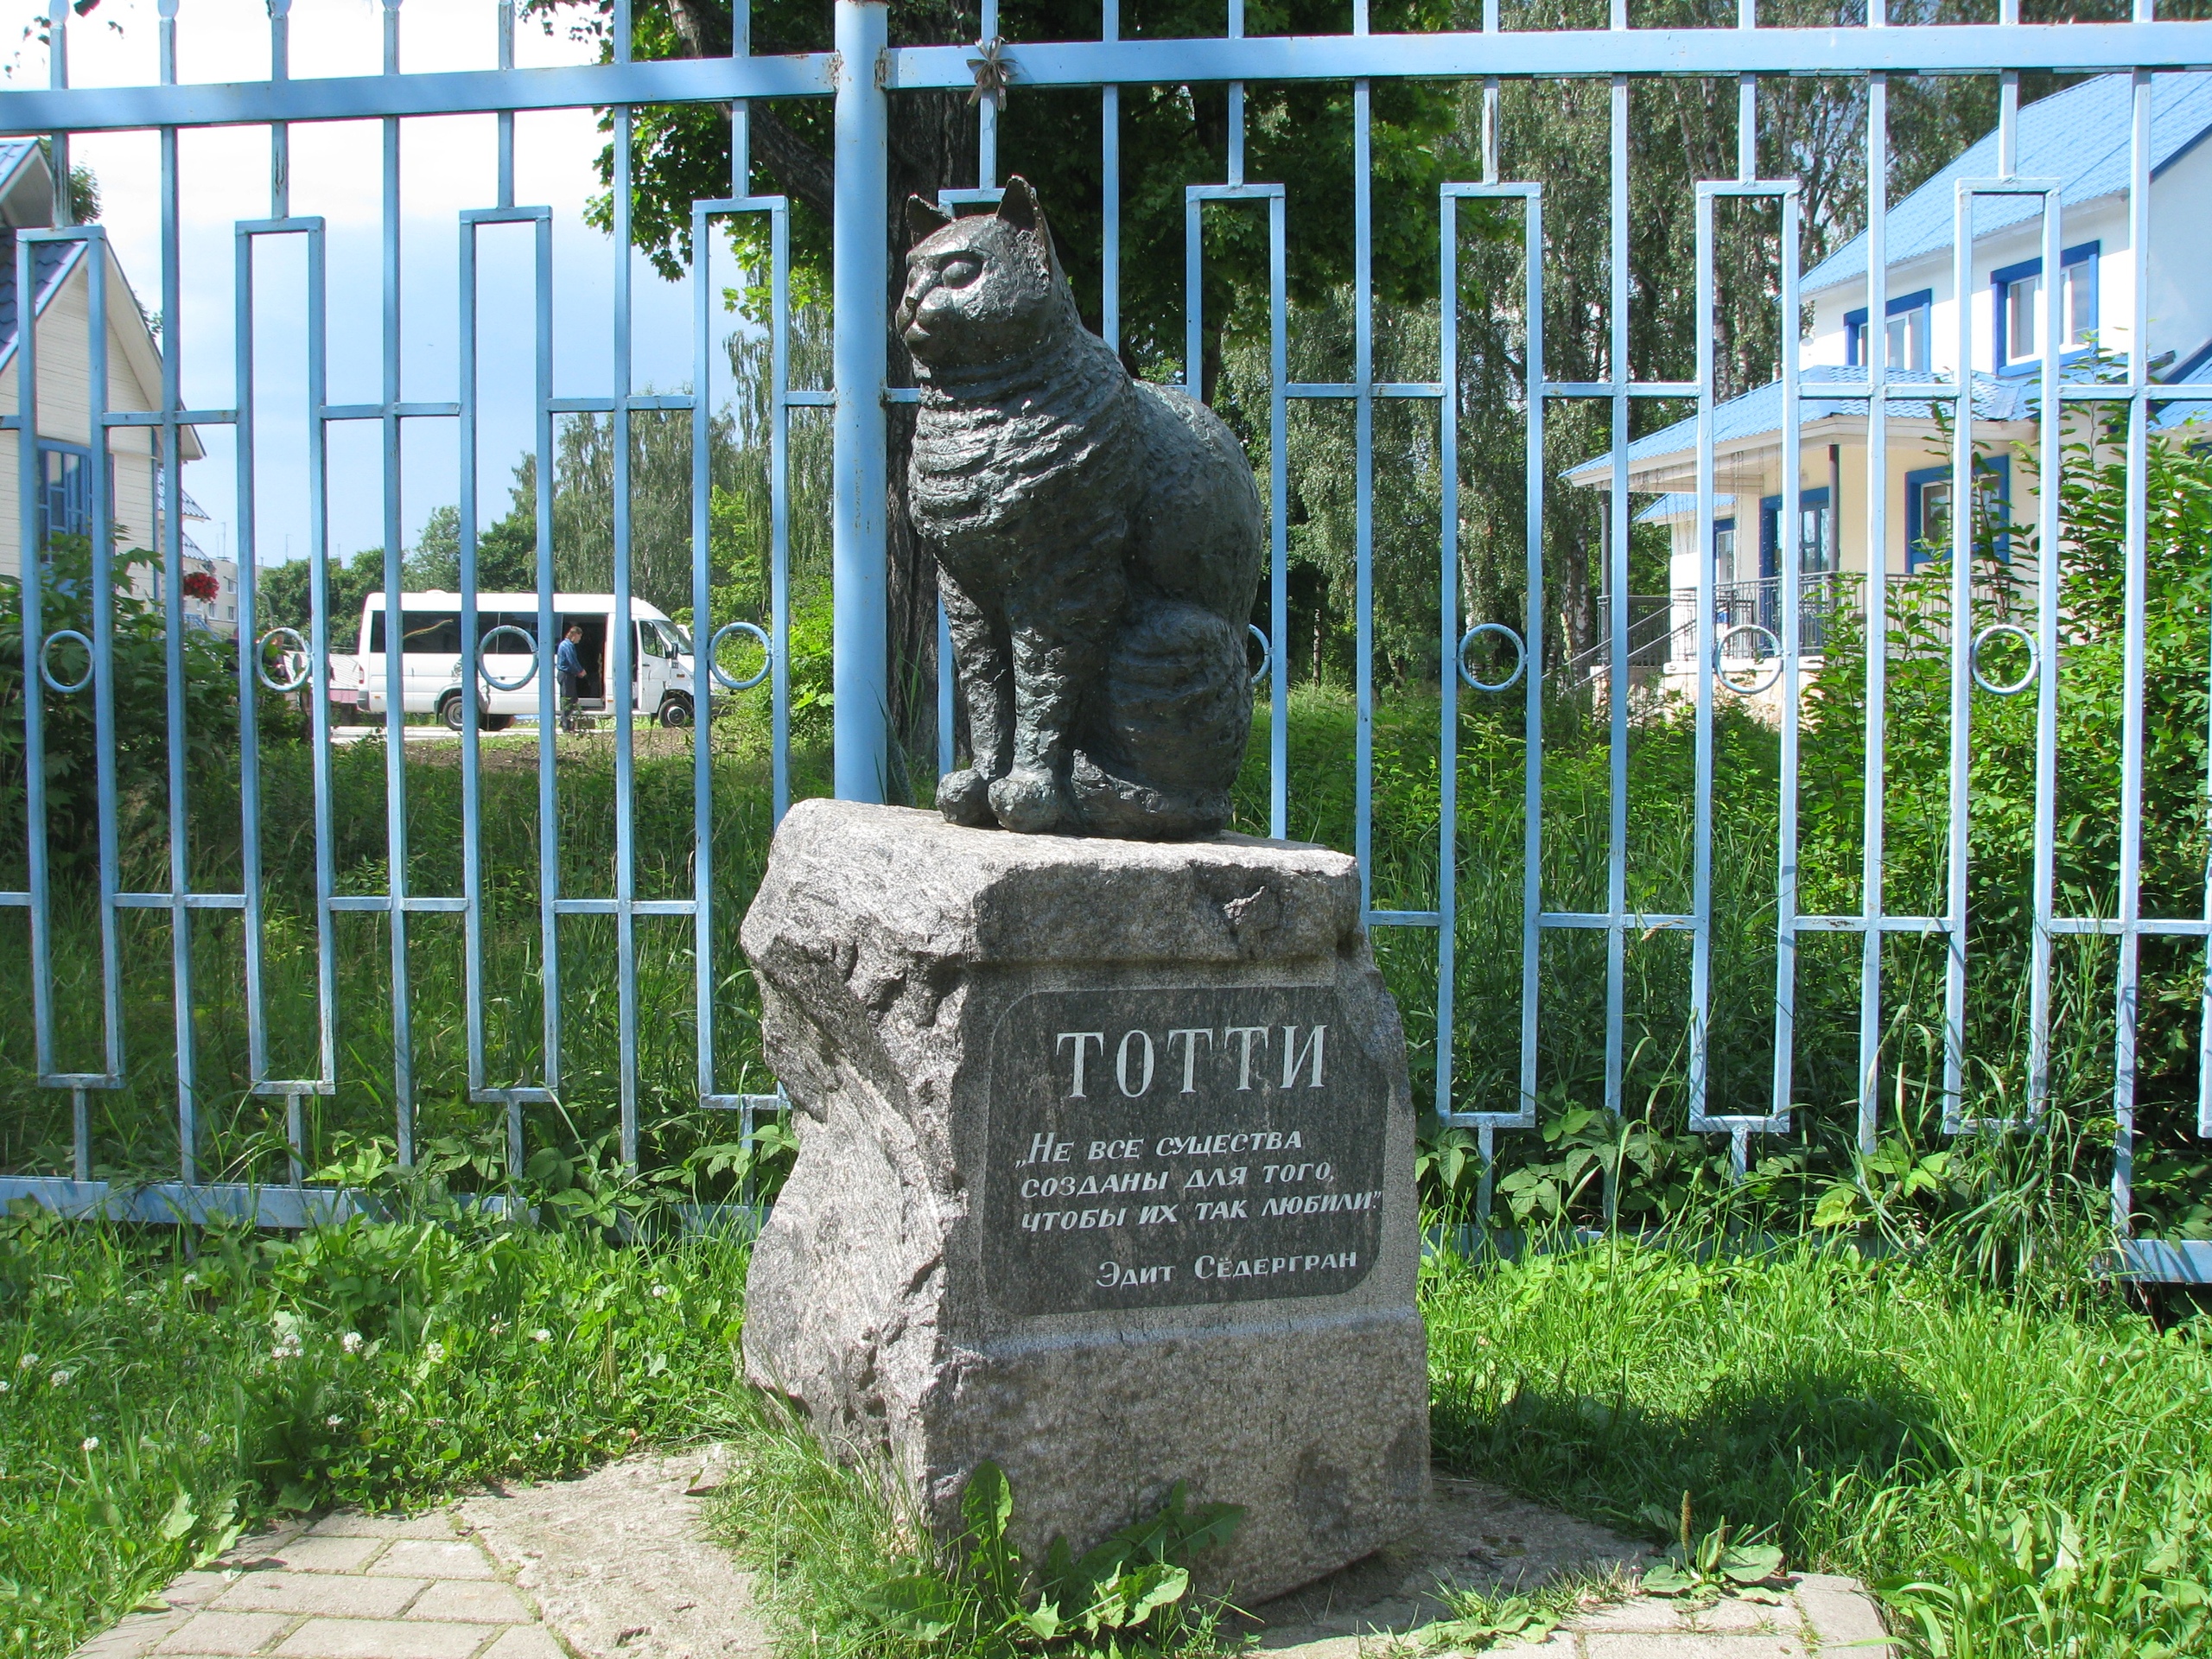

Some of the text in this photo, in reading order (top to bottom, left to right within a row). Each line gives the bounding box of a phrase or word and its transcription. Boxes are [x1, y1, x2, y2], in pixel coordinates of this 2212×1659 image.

[1056, 1025, 1328, 1098] ТОТТИ
[1087, 1138, 1144, 1160] ВСЕ
[1155, 1130, 1302, 1156] СУЩЕСТВА
[1020, 1161, 1335, 1198] СОЗДАНЫ ДЛЯ ТОГО,
[1021, 1206, 1126, 1232] ЧТОБЫ
[1138, 1204, 1179, 1224] ИХ
[1195, 1199, 1249, 1221] ТАК
